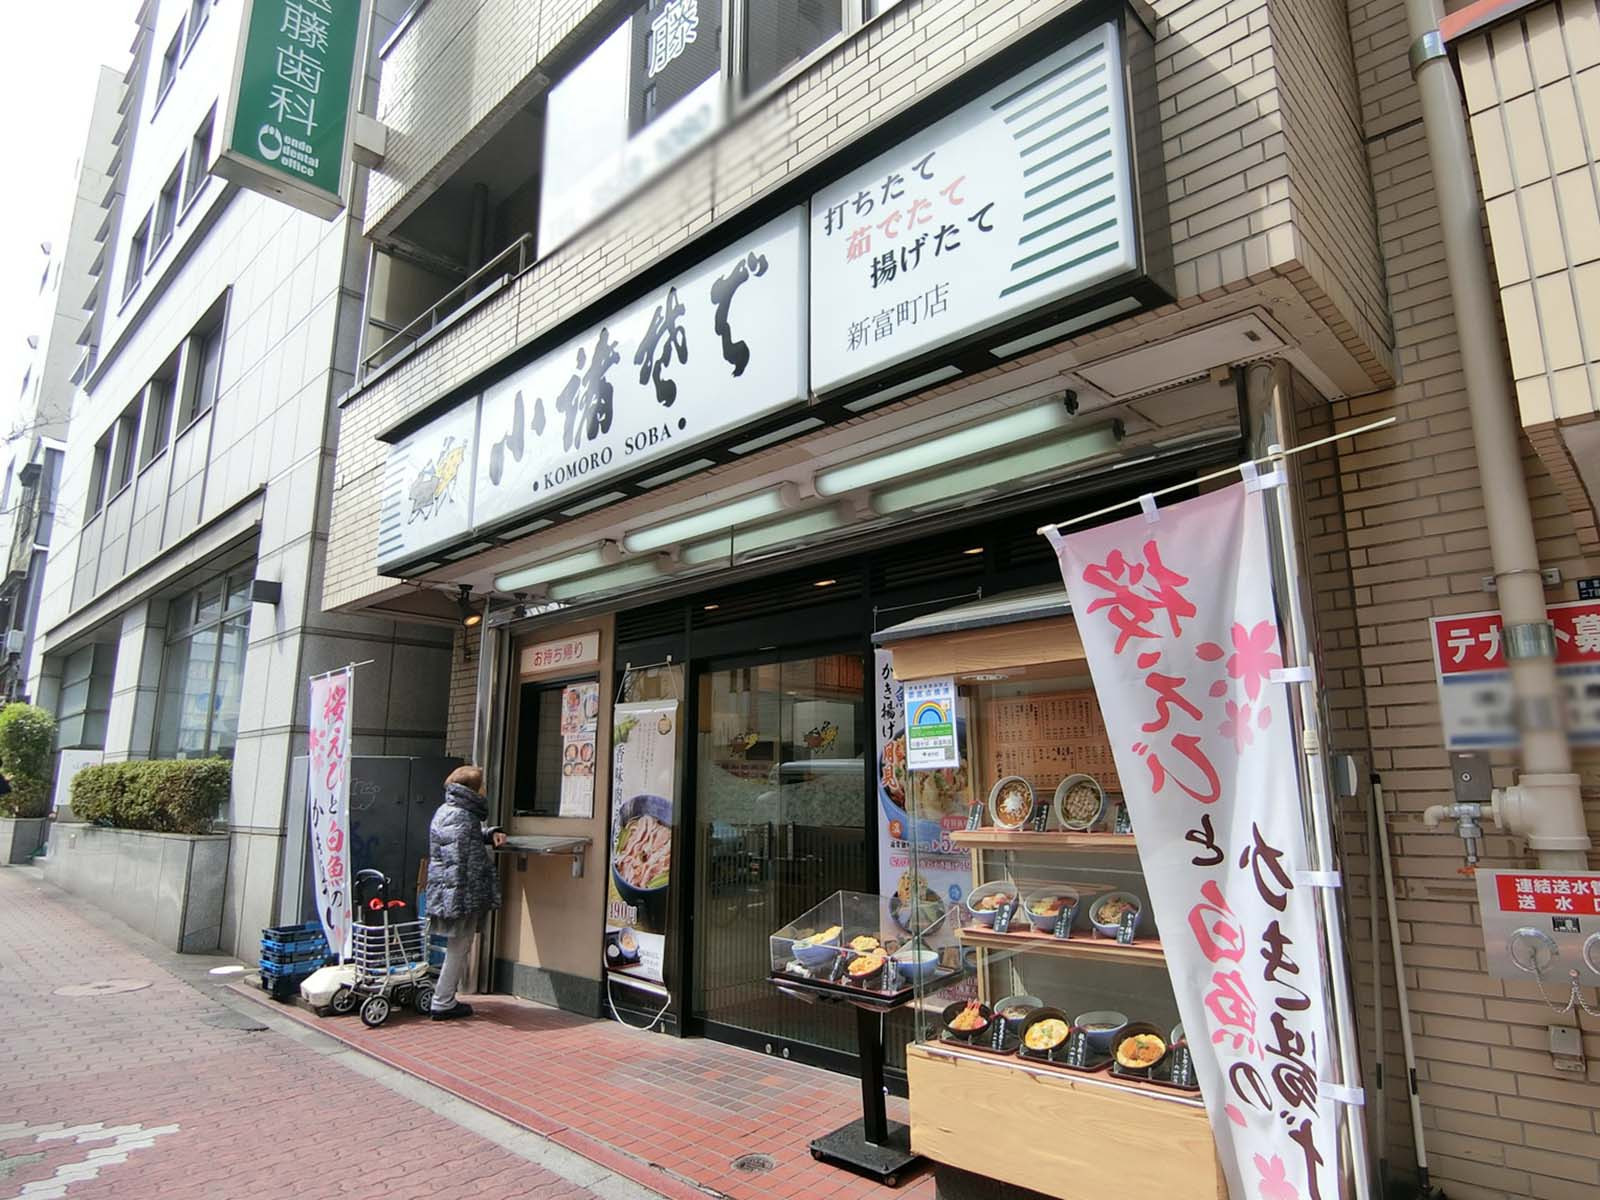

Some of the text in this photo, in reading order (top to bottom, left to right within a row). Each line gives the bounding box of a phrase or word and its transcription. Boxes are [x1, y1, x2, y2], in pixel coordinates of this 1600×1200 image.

[268, 0, 333, 137] 藤歯科
[281, 156, 314, 176] office
[282, 145, 319, 168] dental
[284, 135, 312, 154] endo
[824, 151, 936, 236] 打ちたて
[845, 175, 966, 264] 茹でたて
[870, 202, 995, 289] 揚げたて
[846, 281, 951, 352] 新富町店
[544, 422, 673, 491] KOMORO SOBA
[533, 641, 584, 667] お持ち帰り
[881, 663, 897, 740] かき揚げ
